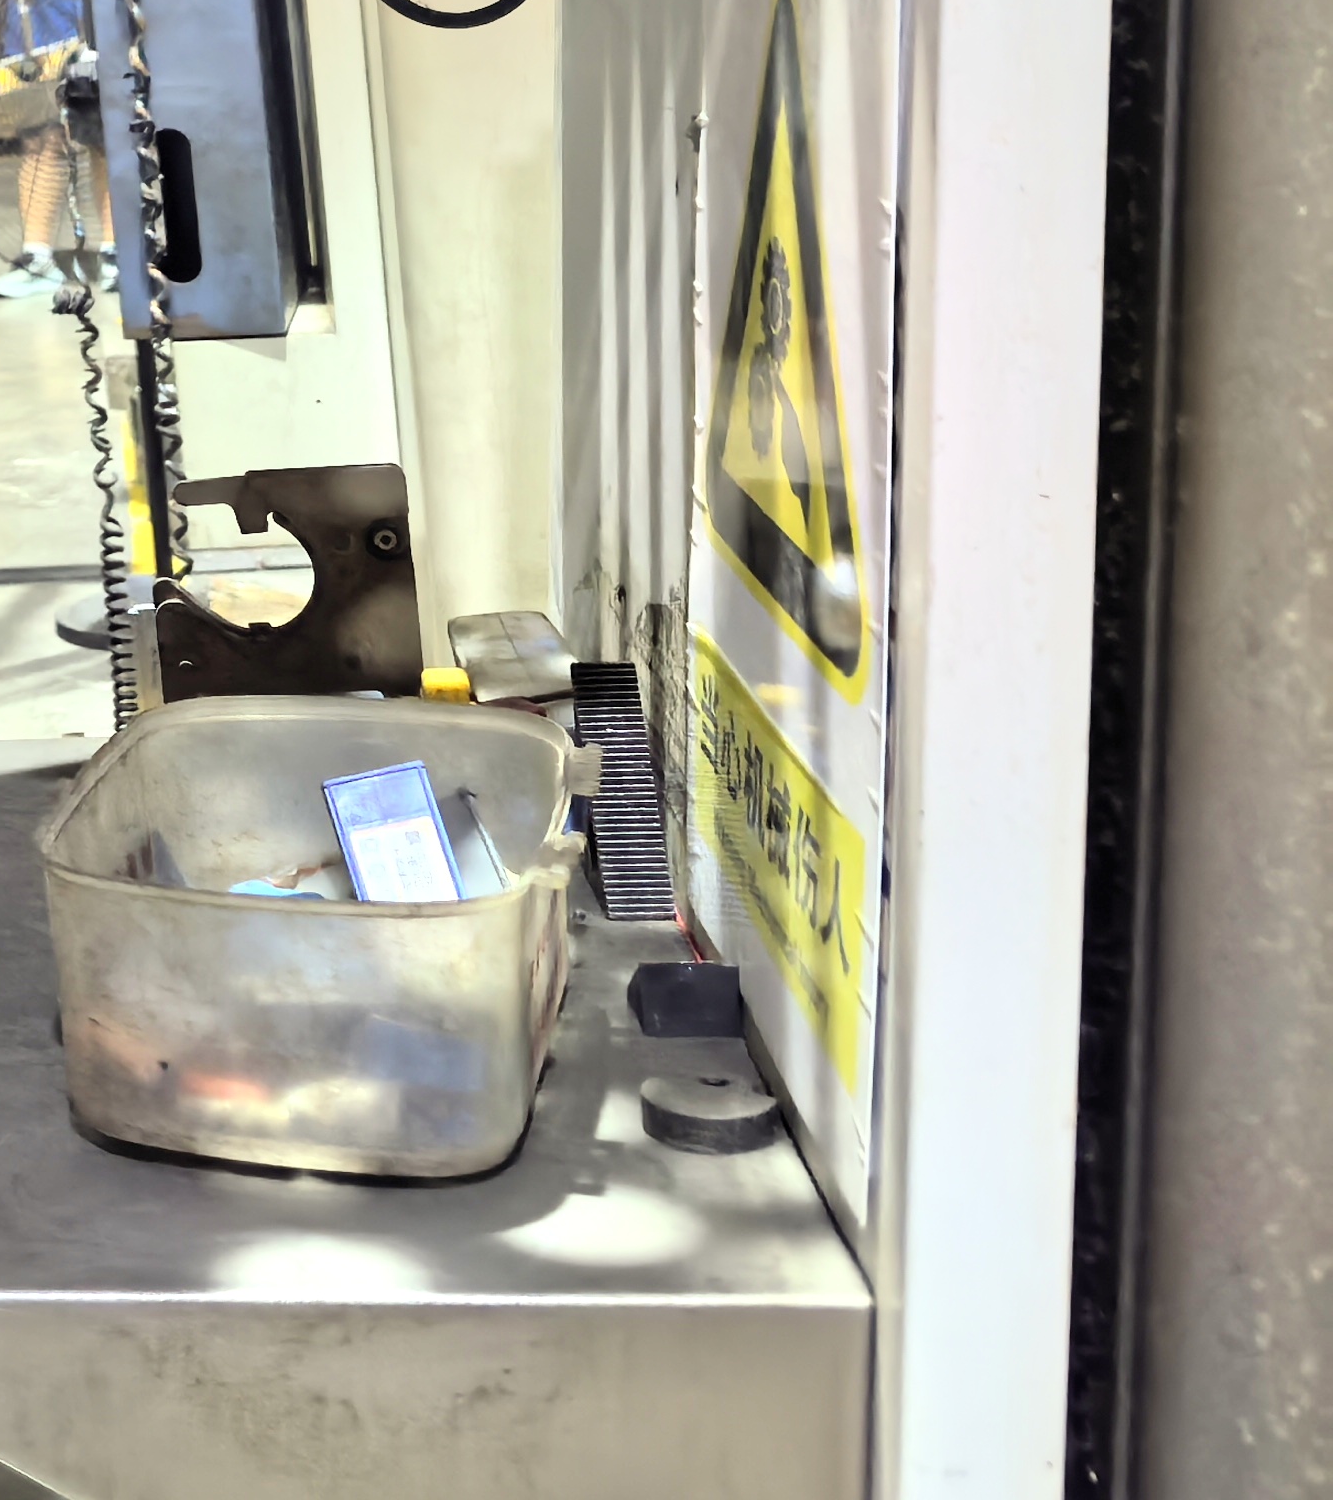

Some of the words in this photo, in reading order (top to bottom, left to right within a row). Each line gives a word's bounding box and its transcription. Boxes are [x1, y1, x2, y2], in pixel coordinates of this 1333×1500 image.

[699, 672, 852, 977] 当心机械伤人
